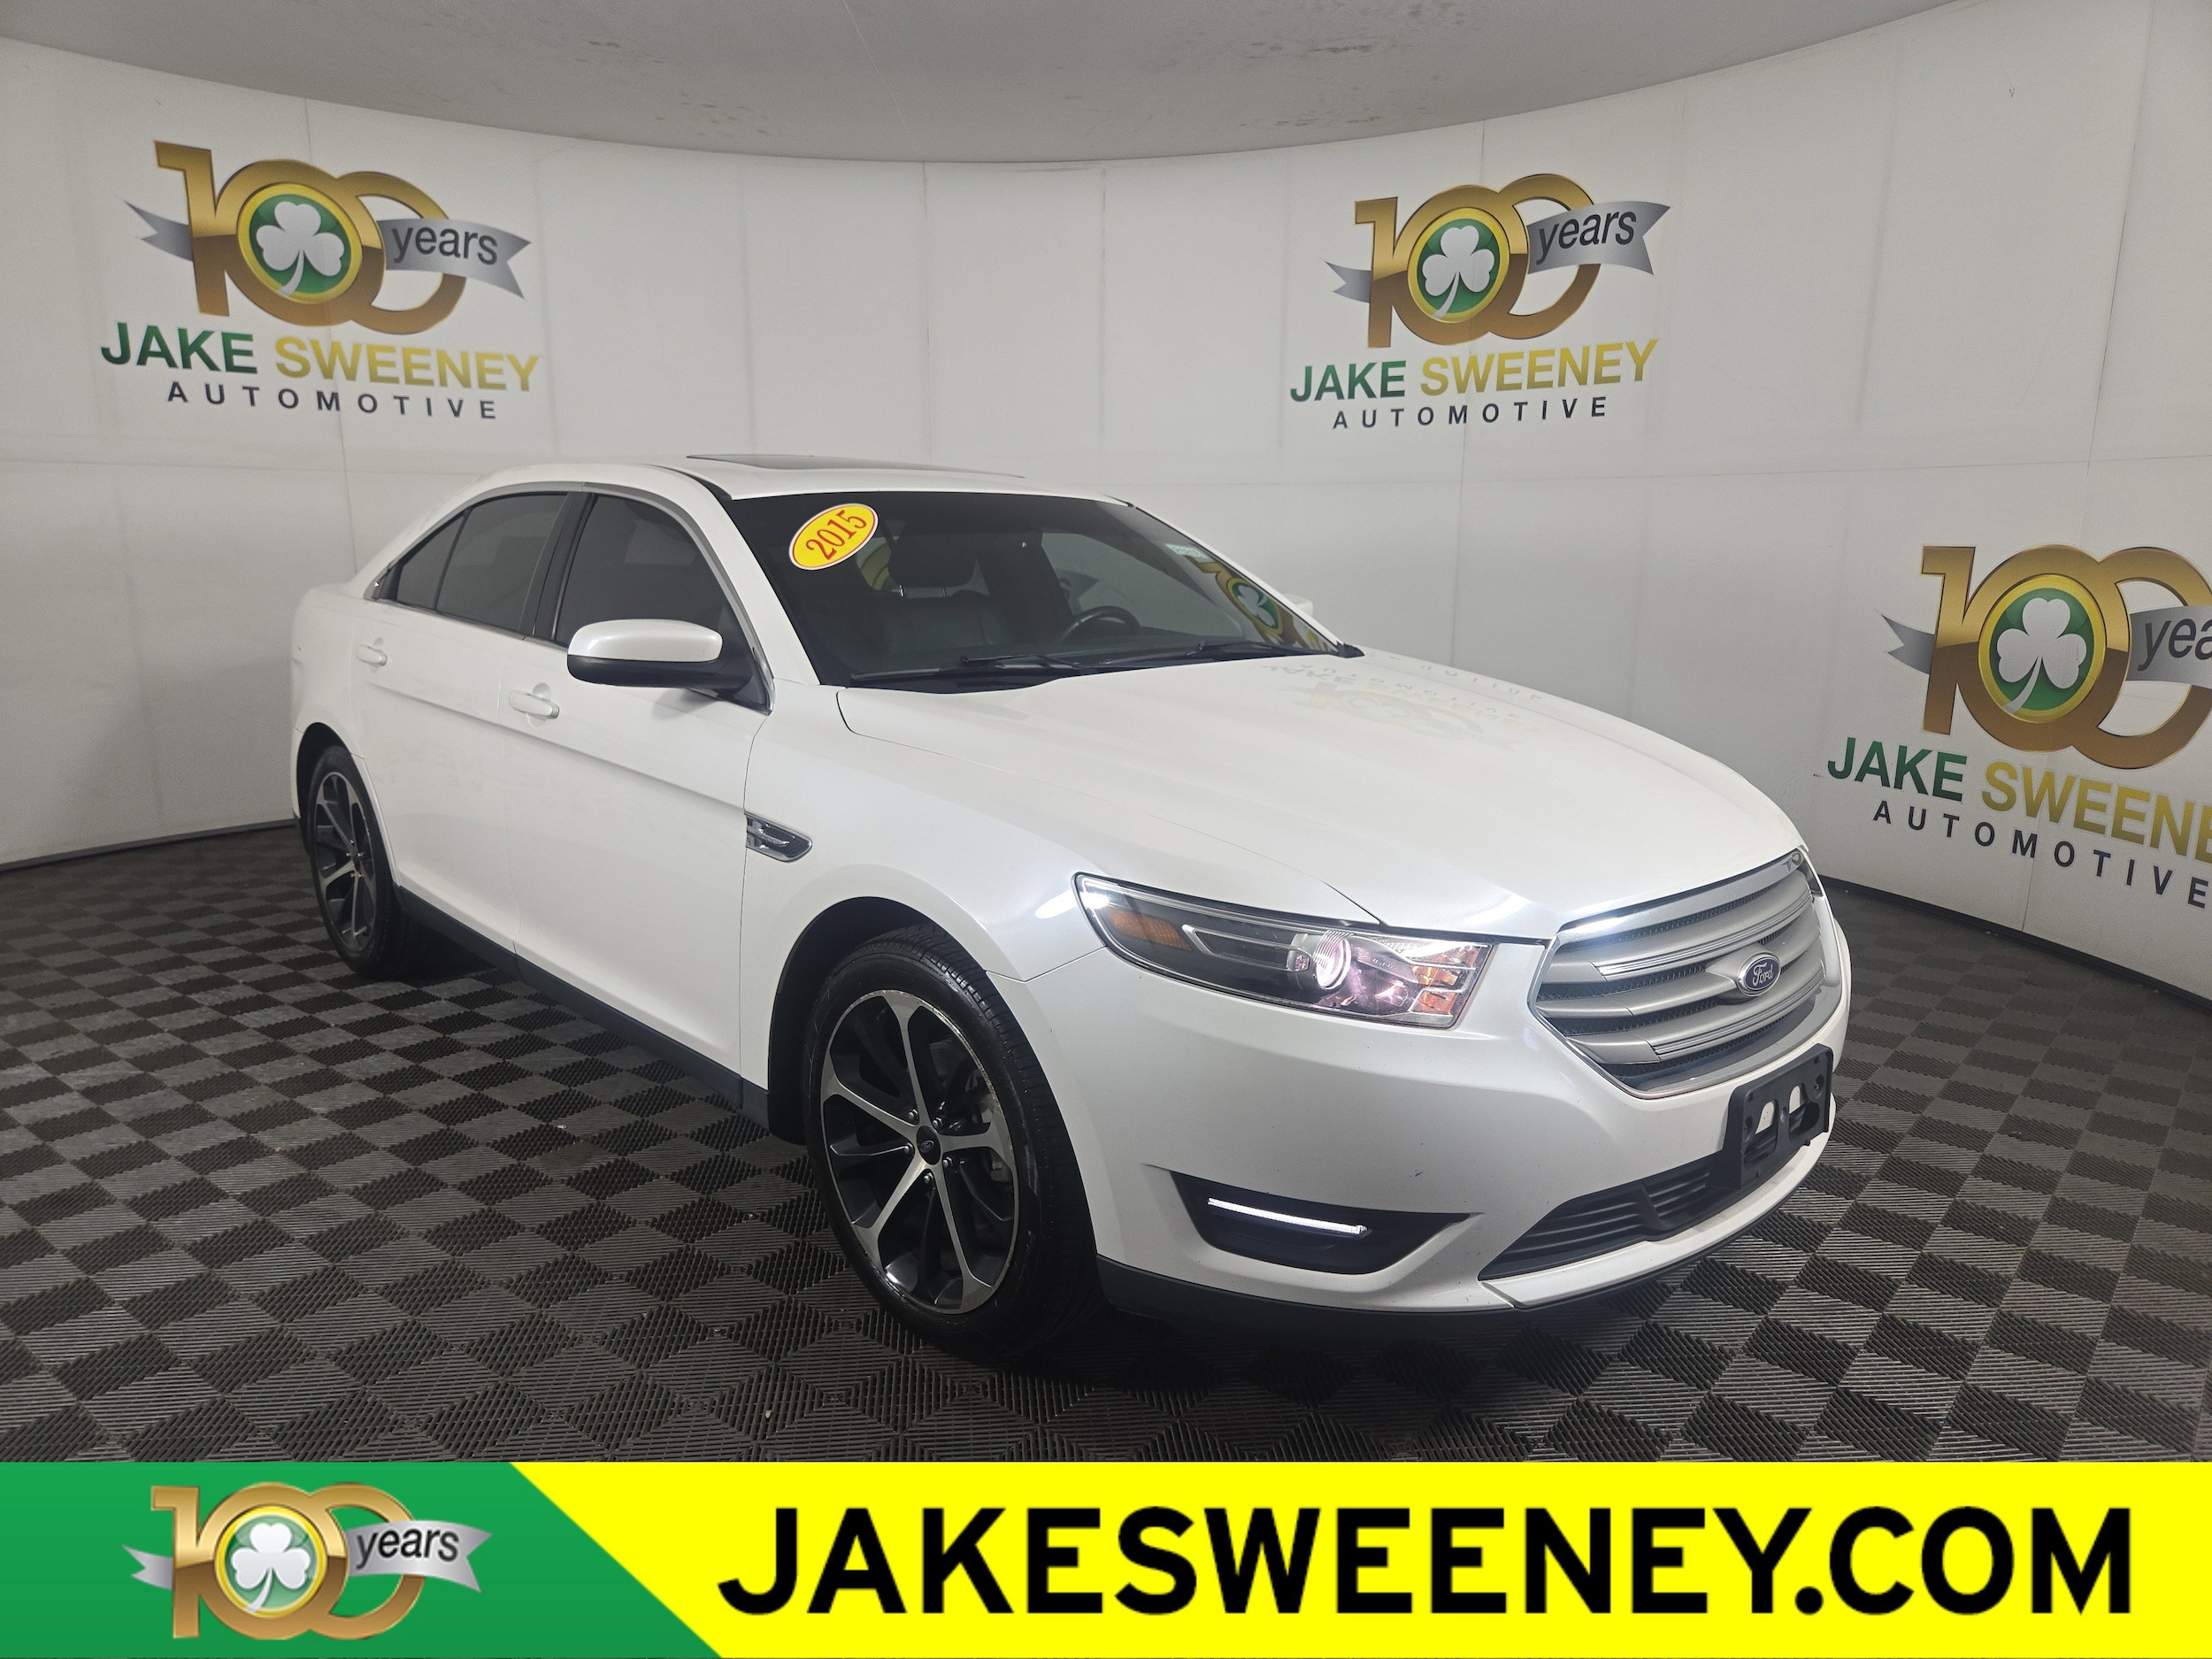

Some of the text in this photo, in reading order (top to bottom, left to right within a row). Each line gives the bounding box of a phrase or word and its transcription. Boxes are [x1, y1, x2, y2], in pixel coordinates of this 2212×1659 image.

[154, 141, 498, 335] 100 years
[1355, 173, 1637, 349] 100 years
[101, 322, 540, 391] JAKE SWEENEY
[1290, 339, 1659, 402] JAKE SWEENEY
[167, 381, 496, 419] AUTOMOTIVE
[1333, 396, 1607, 429] AUTOMOTIVE
[806, 510, 867, 560] 2015
[1827, 737, 1968, 803] JAKE
[1873, 801, 2209, 909] AUTOMOTIVE
[1752, 962, 1773, 987] Ford
